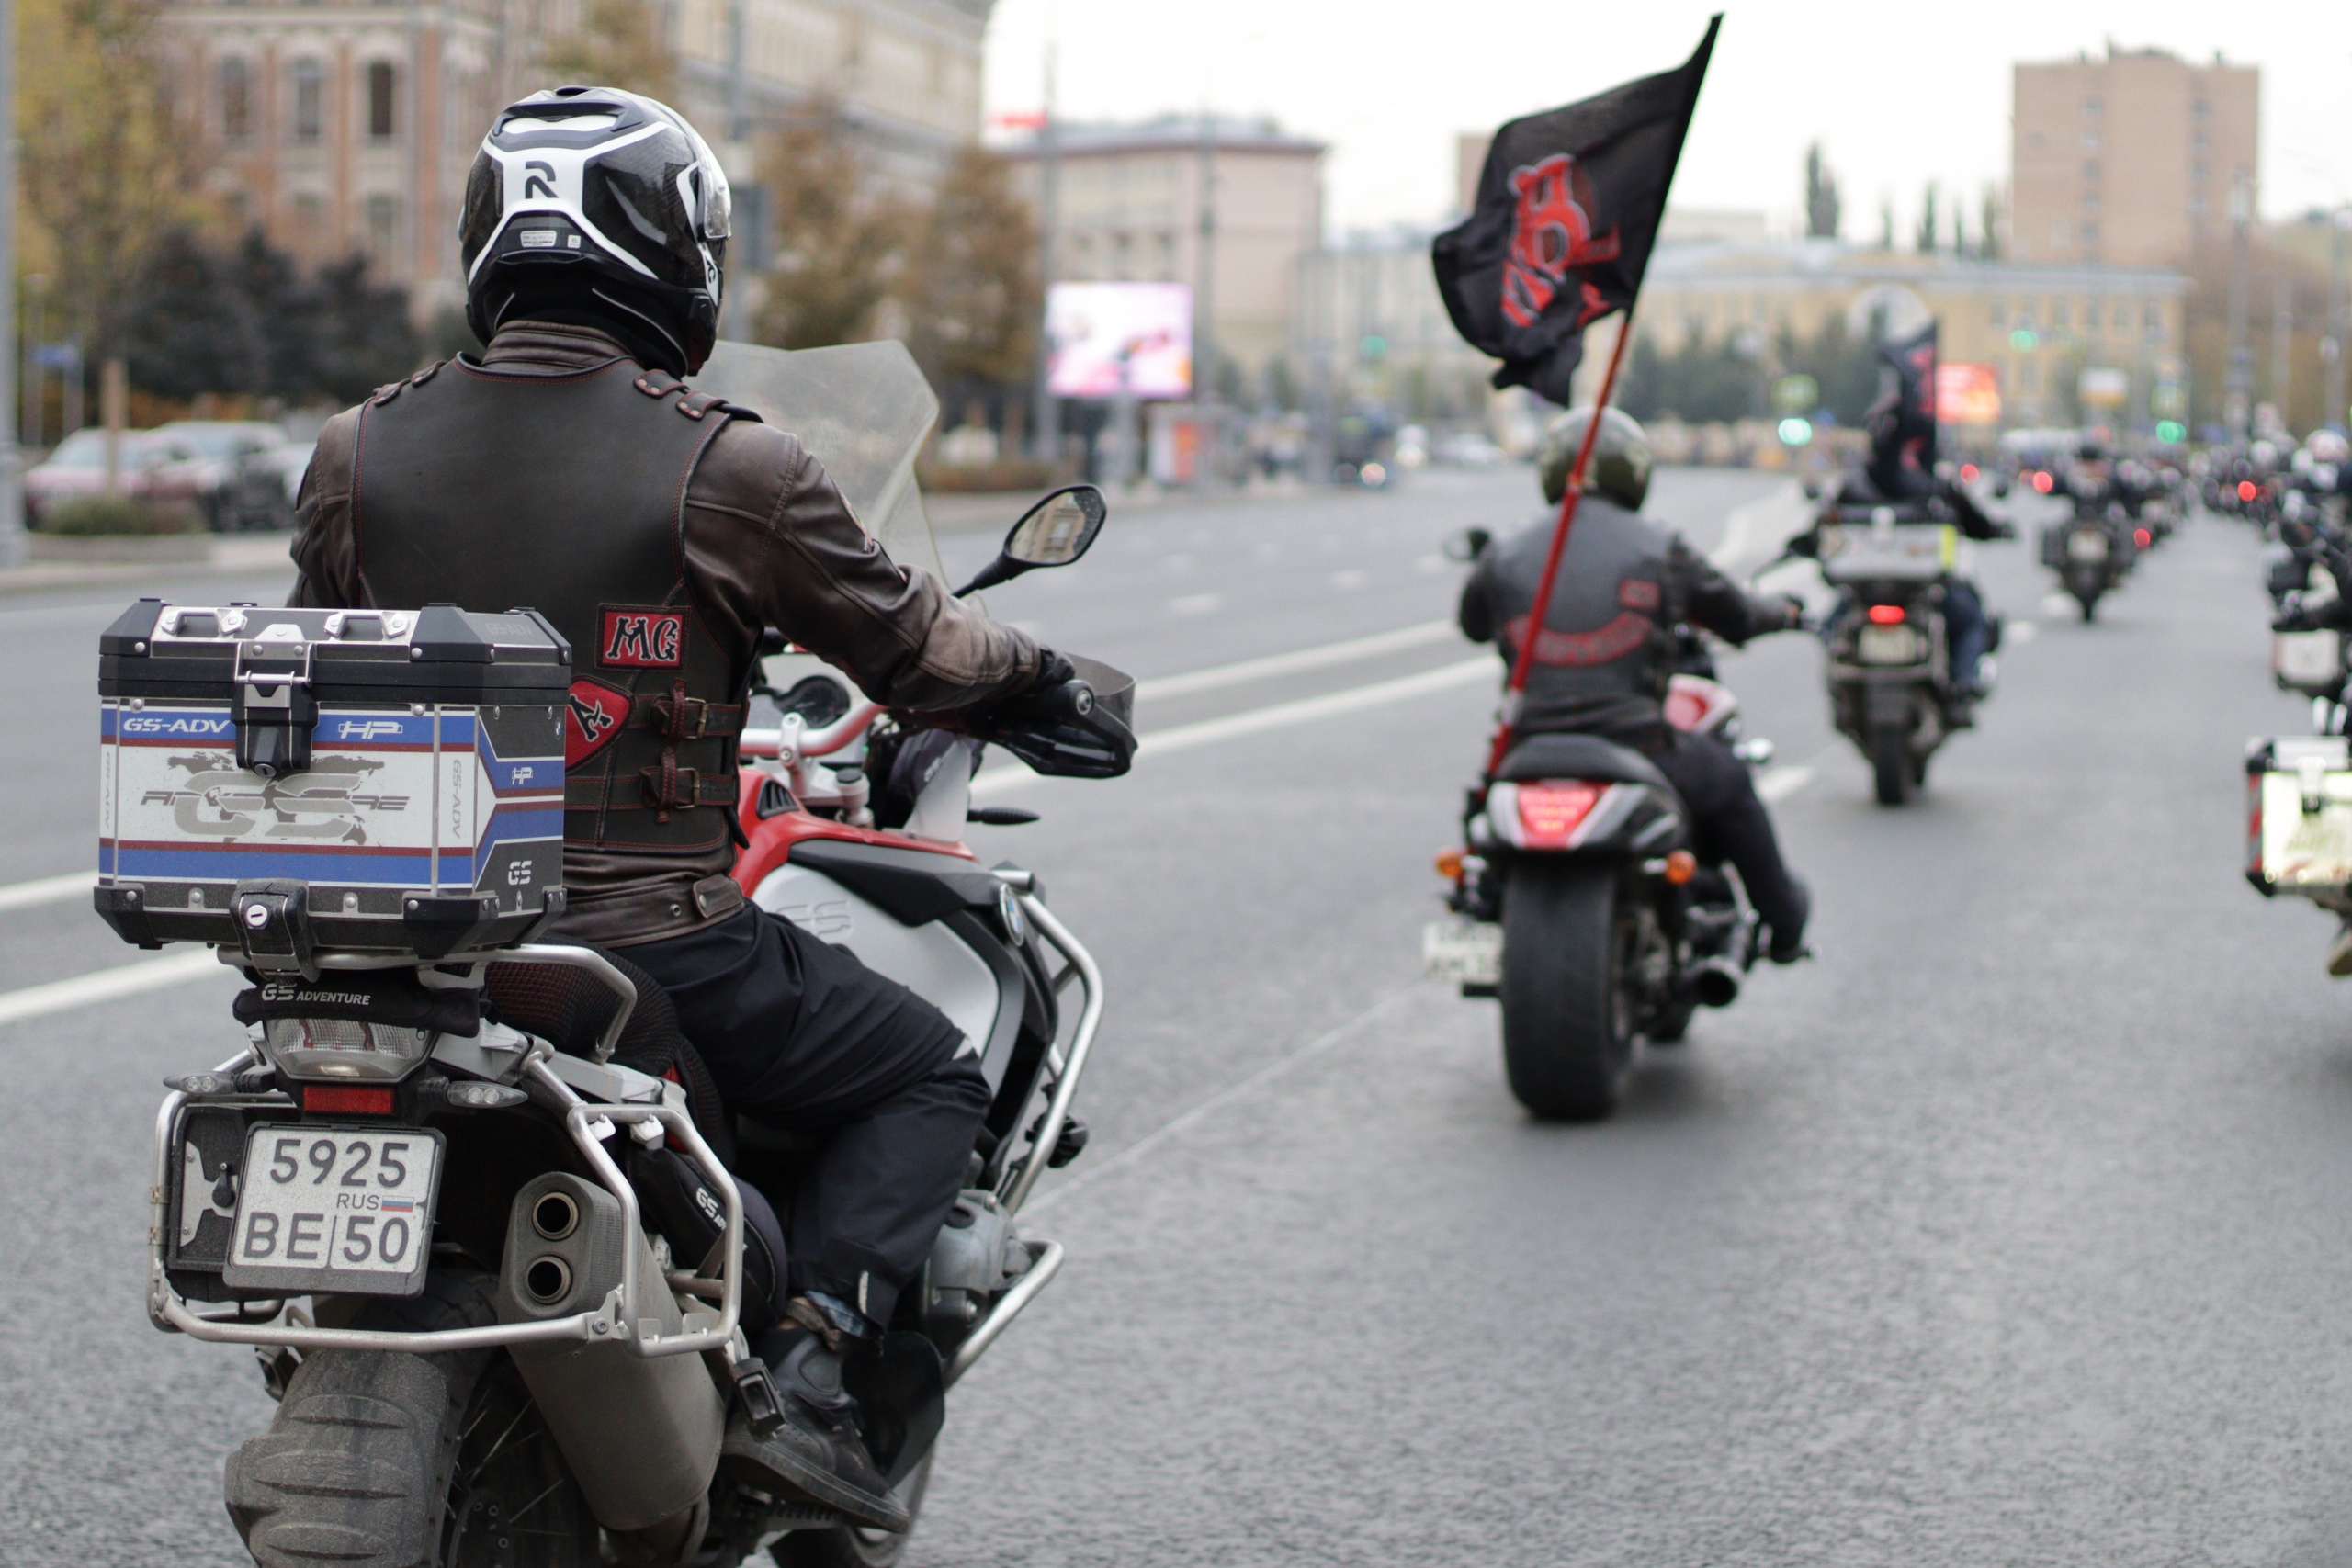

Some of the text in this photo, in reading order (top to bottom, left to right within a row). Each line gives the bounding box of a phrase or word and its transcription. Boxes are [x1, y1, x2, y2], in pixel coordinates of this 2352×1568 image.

[123, 717, 231, 733] GS-ADV
[338, 720, 403, 739] HP
[507, 860, 533, 886] GS
[261, 982, 371, 1006] GS ADVENTURE
[269, 1138, 410, 1189] 5925
[336, 1193, 379, 1211] RUS
[695, 1188, 719, 1219] GS
[343, 1215, 410, 1264] 50
